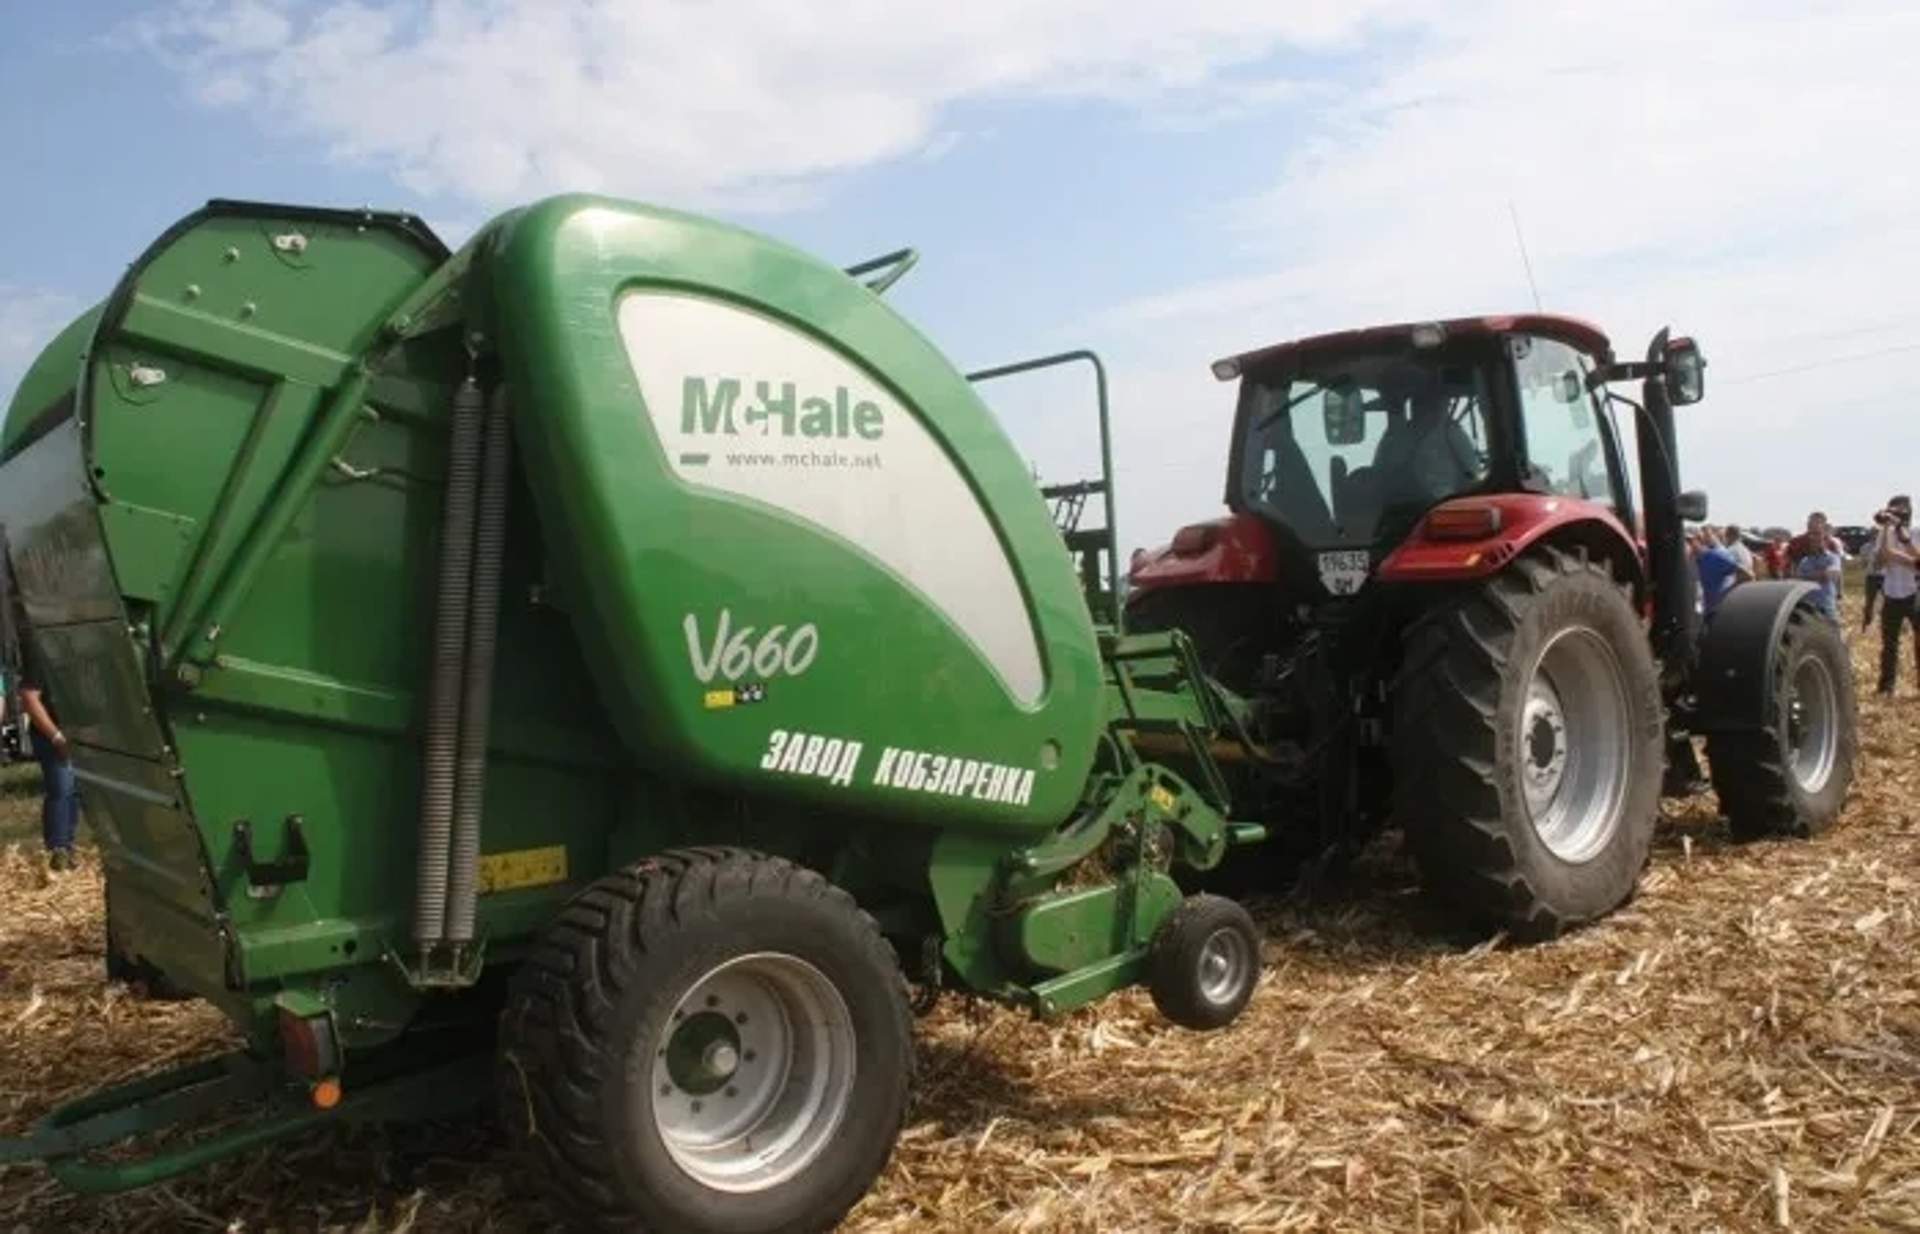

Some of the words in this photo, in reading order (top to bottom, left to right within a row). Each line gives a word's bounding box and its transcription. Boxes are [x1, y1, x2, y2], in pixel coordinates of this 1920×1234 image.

[727, 452, 882, 469] www.mchale.net
[683, 608, 818, 682] V660
[761, 729, 863, 786] ЗАВОД
[873, 746, 1035, 806] КОБЗАРЕНКА
